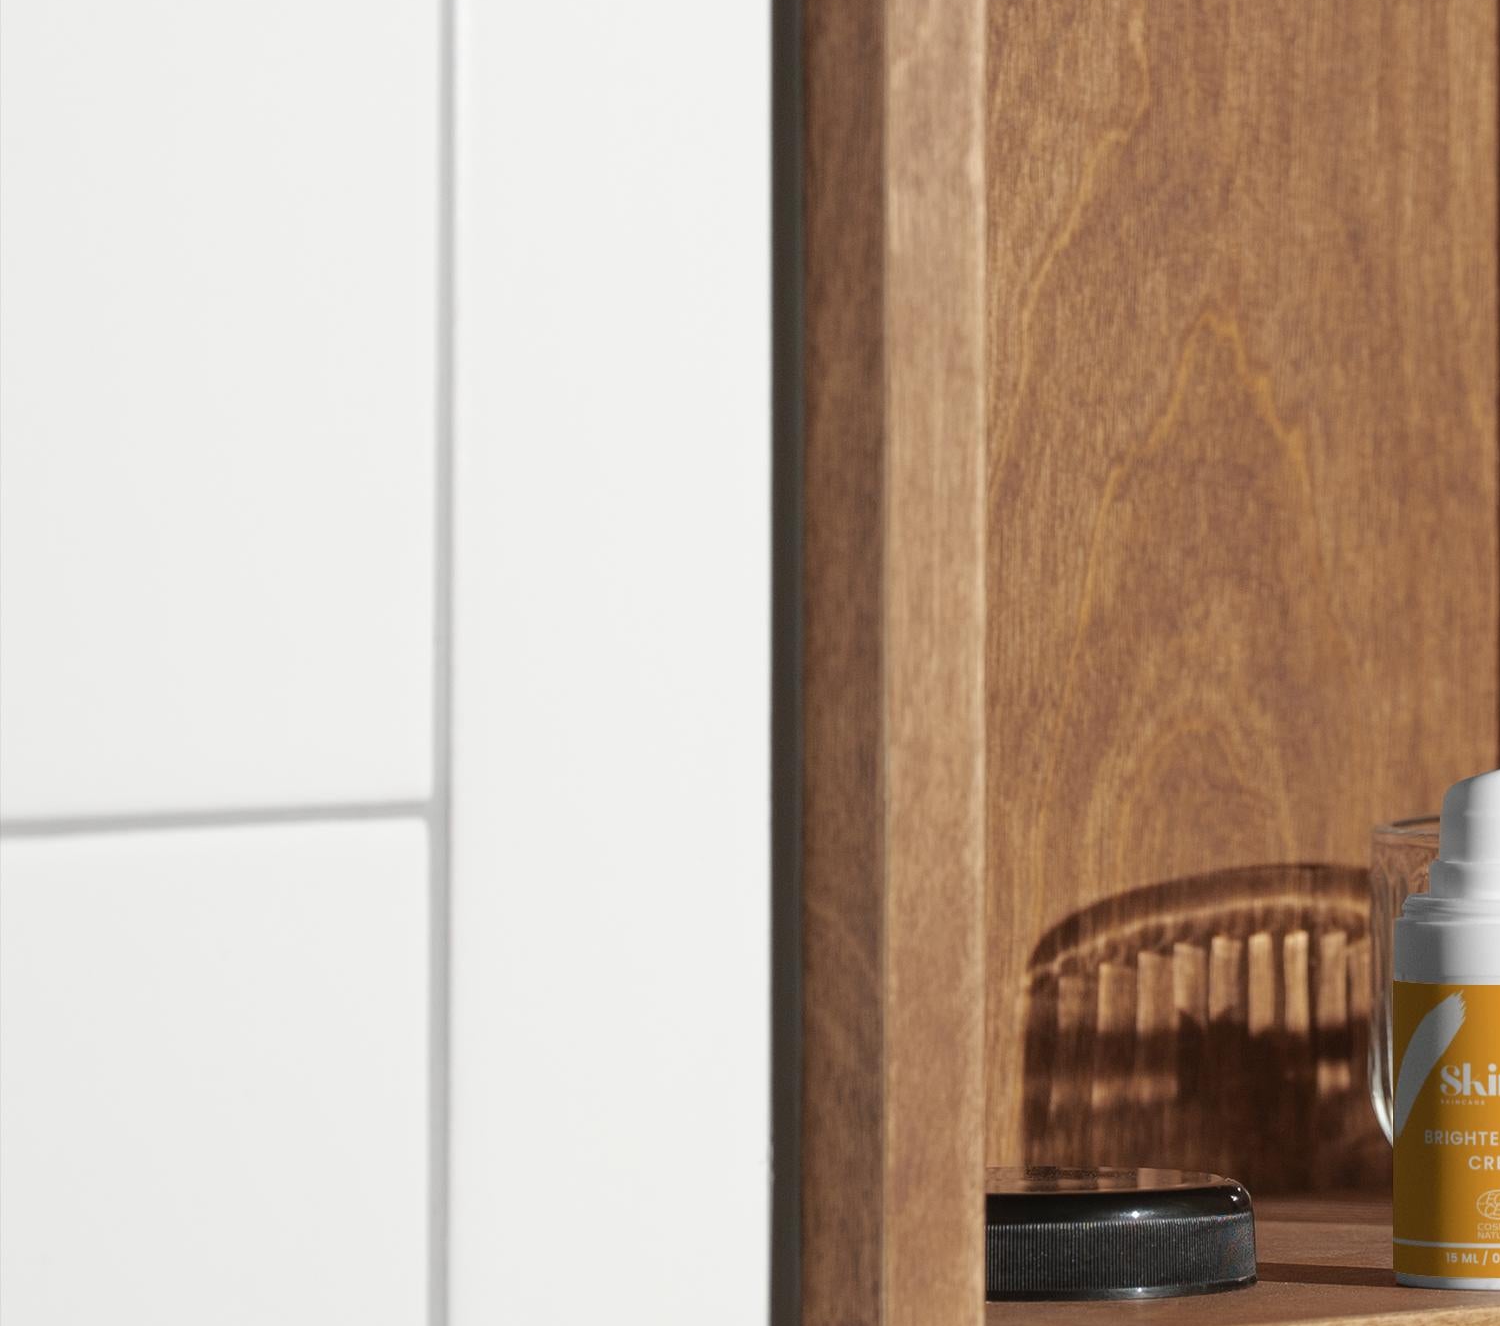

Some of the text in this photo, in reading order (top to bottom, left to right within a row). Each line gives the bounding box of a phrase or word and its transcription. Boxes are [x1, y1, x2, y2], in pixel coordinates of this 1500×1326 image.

[1445, 1252, 1458, 1263] 15
[1461, 1252, 1479, 1264] ML
[1482, 1250, 1489, 1266] /
